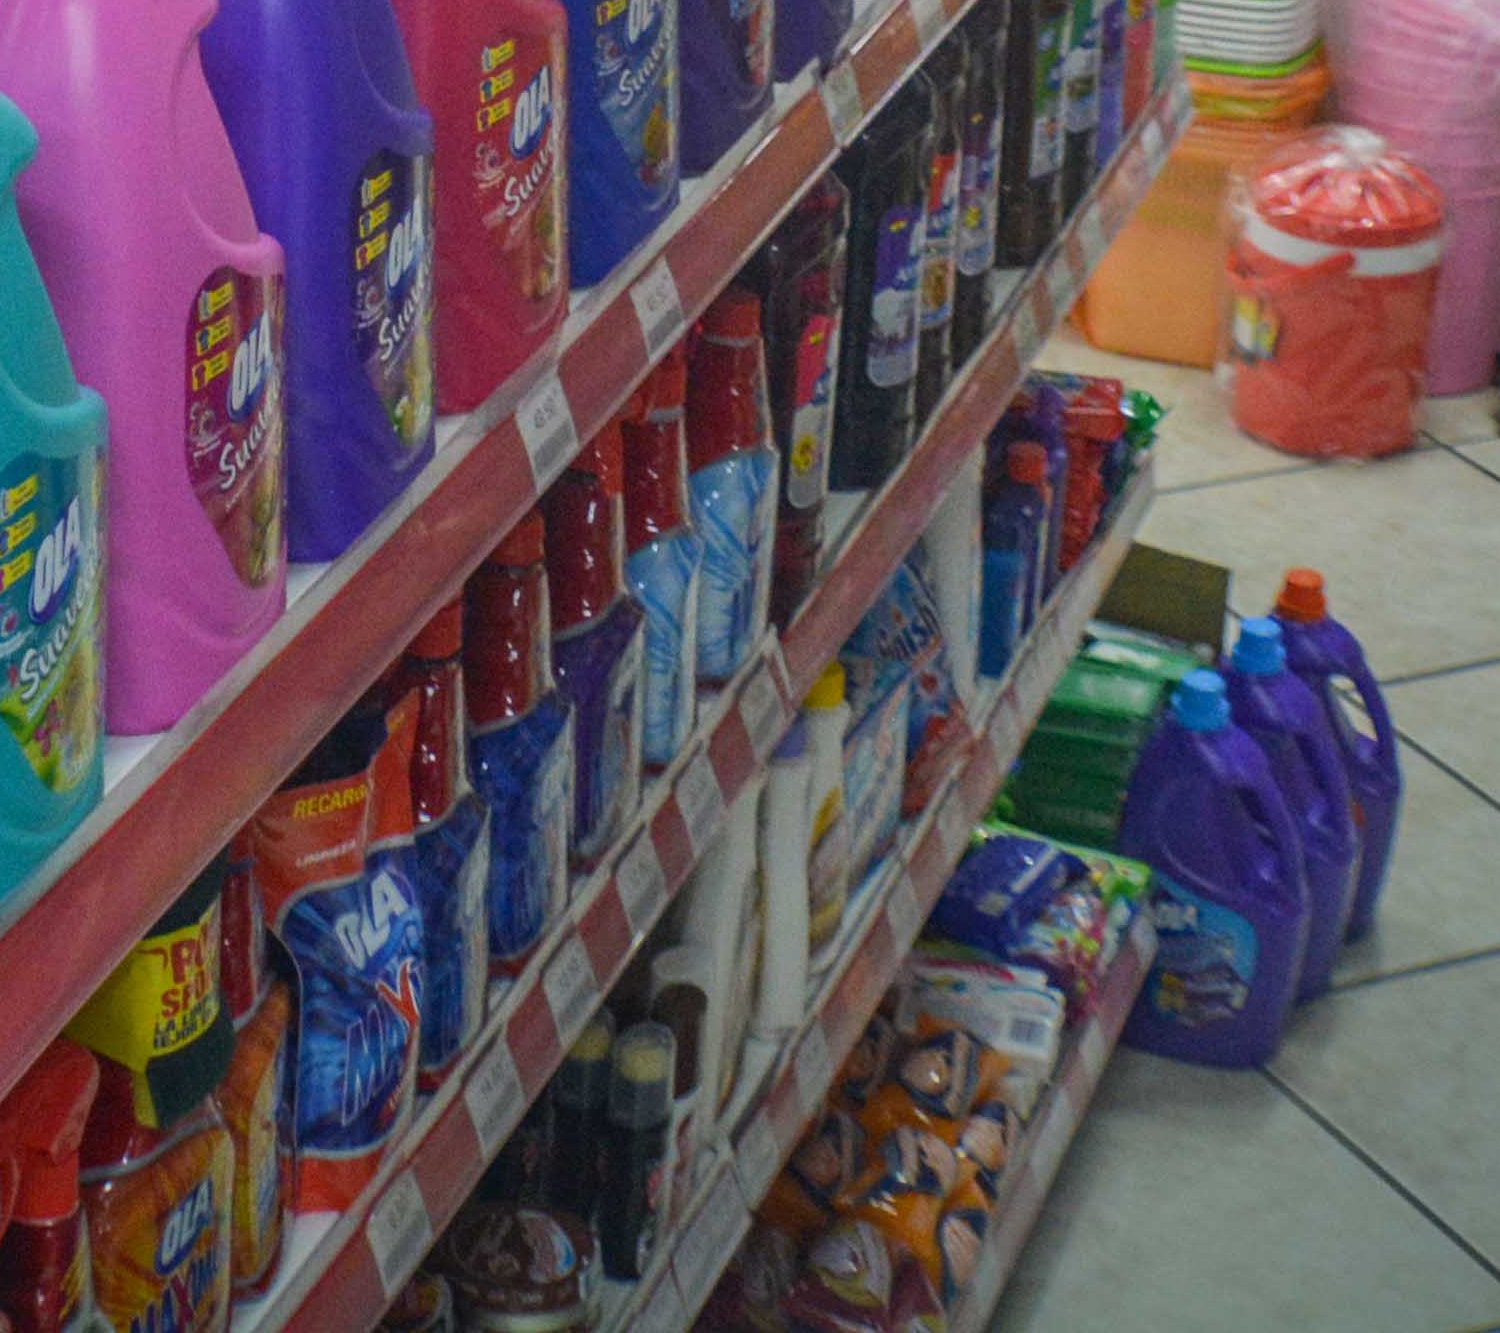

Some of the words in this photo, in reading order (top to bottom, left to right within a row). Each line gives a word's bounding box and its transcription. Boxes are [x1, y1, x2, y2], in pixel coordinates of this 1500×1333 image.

[512, 67, 552, 156] OLA
[386, 190, 425, 290] OLA
[228, 310, 270, 413] OLA
[34, 495, 80, 616] OLA
[292, 784, 368, 819] RECARG
[333, 873, 410, 973] OLA
[160, 1180, 211, 1266] OLA
